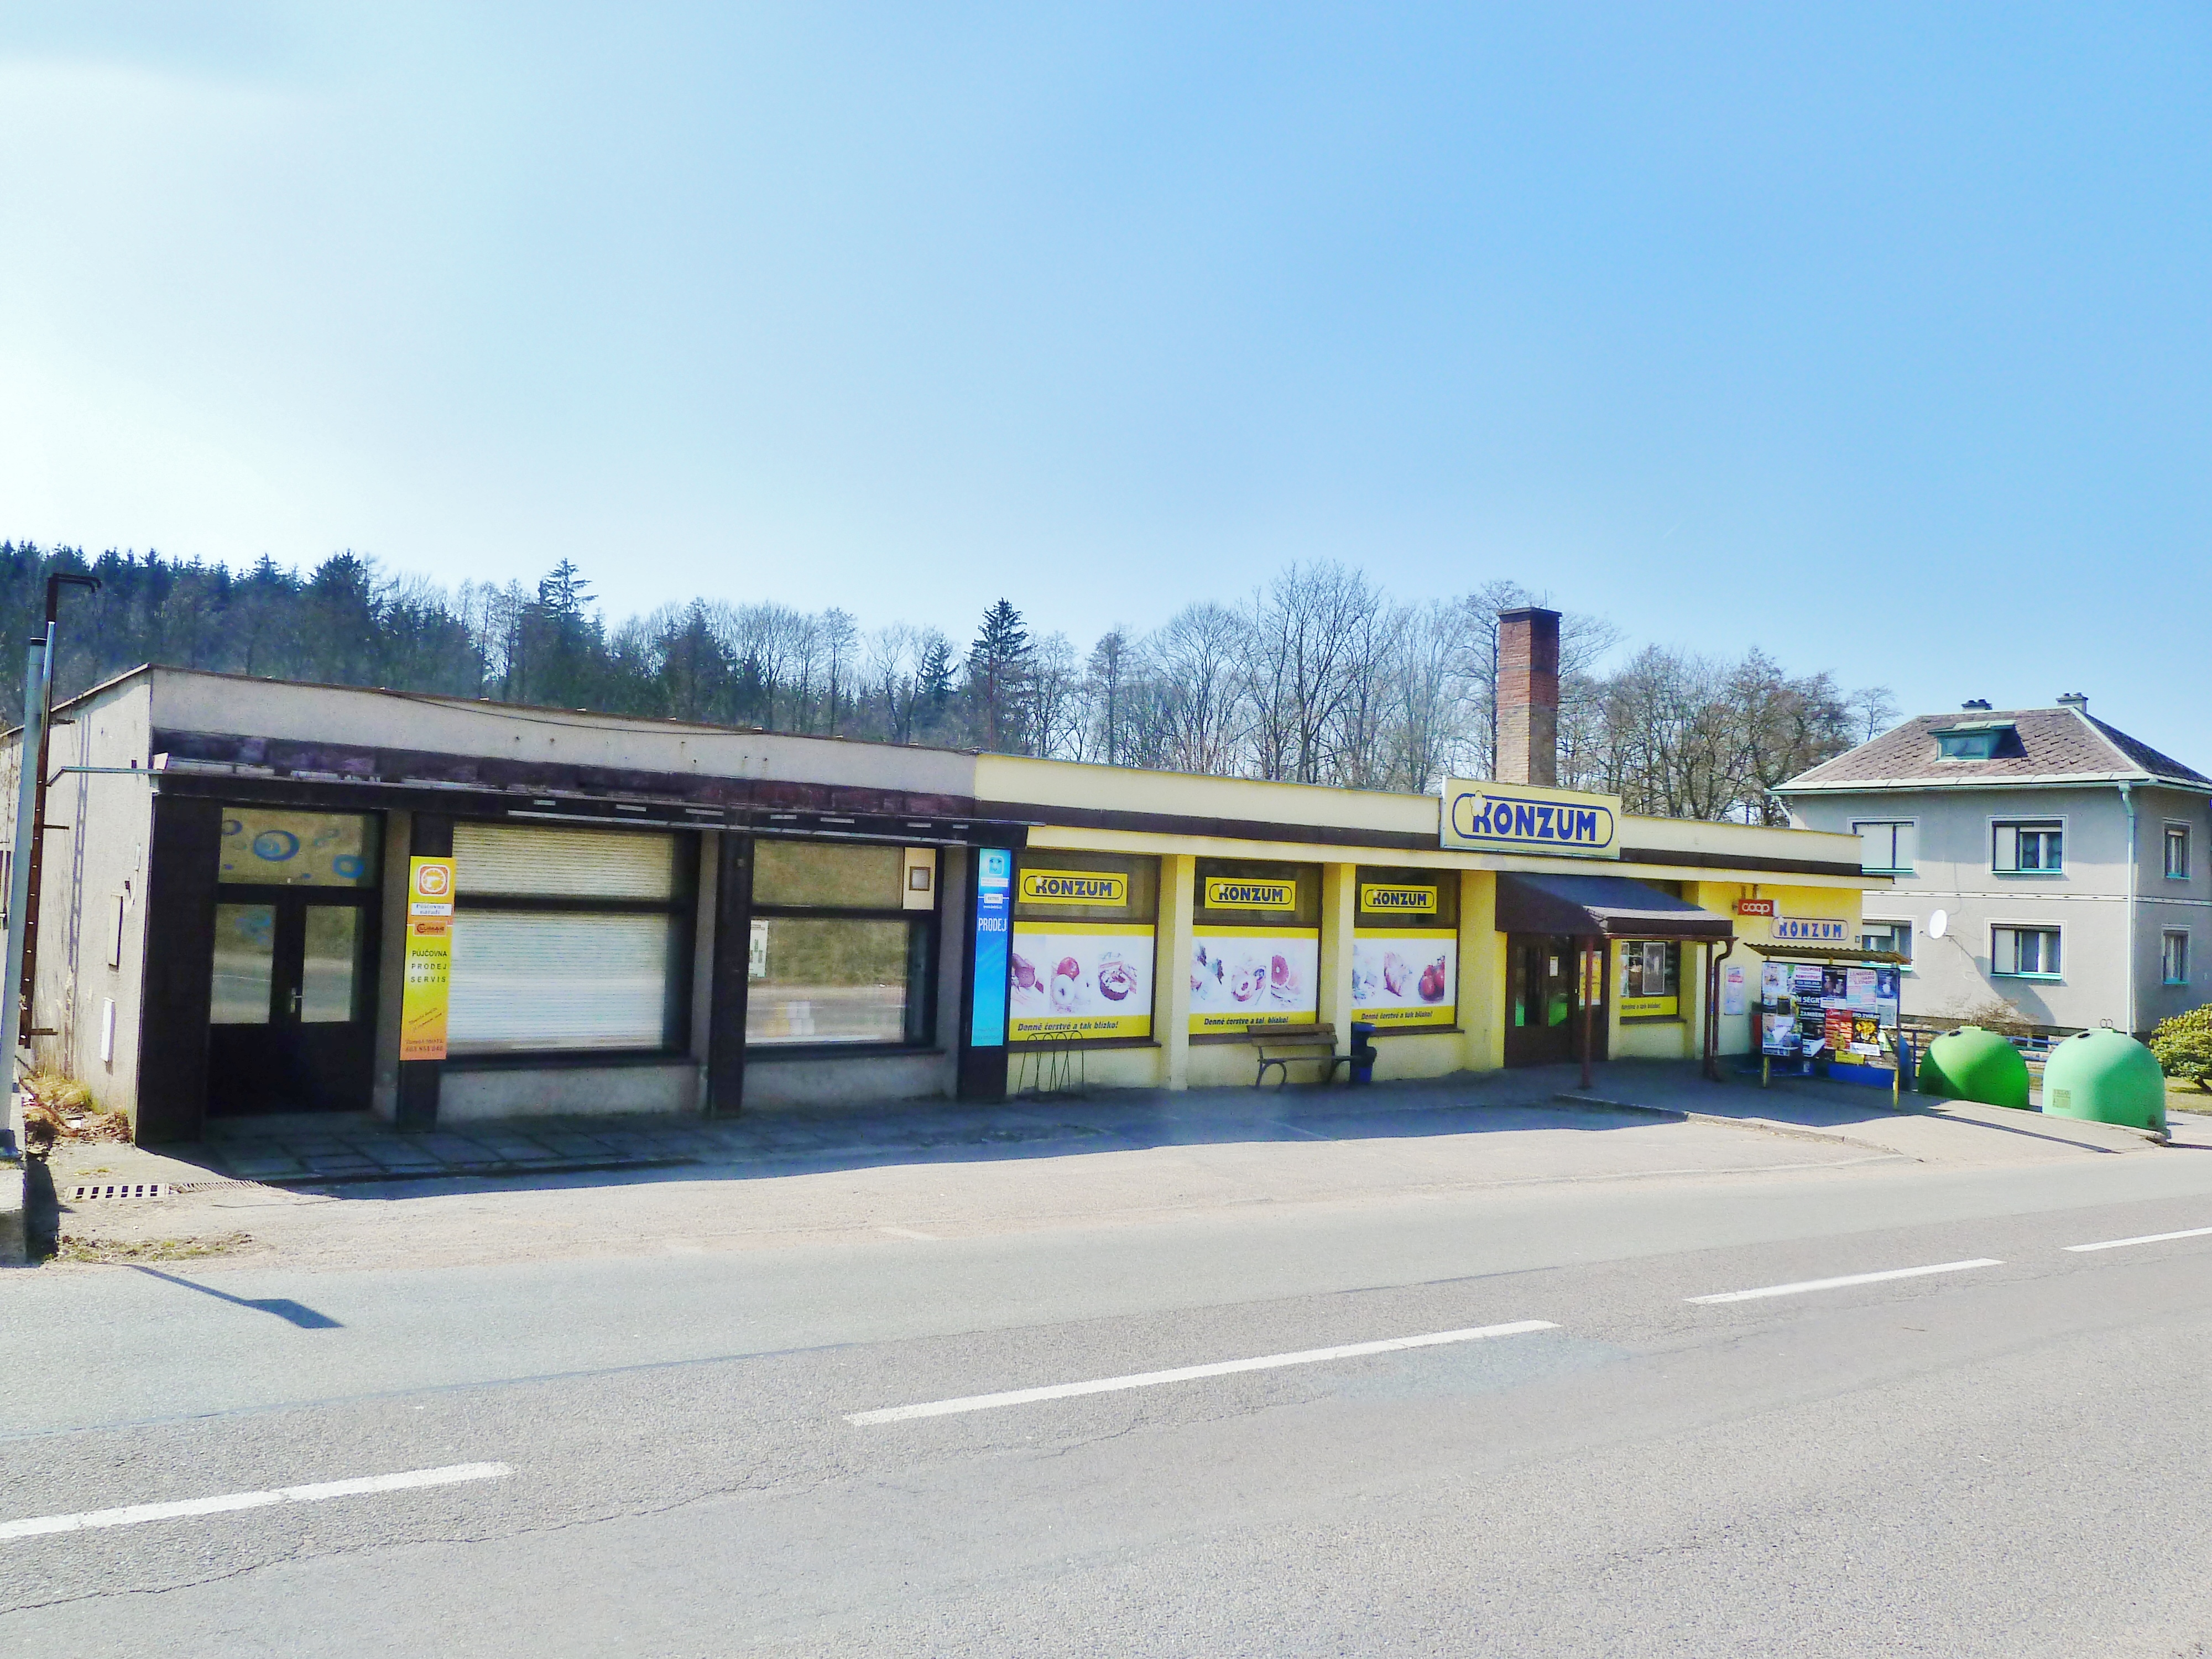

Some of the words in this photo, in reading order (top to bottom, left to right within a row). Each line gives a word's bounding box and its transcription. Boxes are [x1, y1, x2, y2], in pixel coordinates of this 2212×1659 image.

[1472, 802, 1597, 842] KONZUM
[1035, 879, 1112, 896] KONZUM
[1219, 886, 1283, 902] KONZUM
[1373, 891, 1427, 906] KONZUM
[978, 917, 1007, 932] PRODEJ
[1779, 921, 1842, 938] KONZUM
